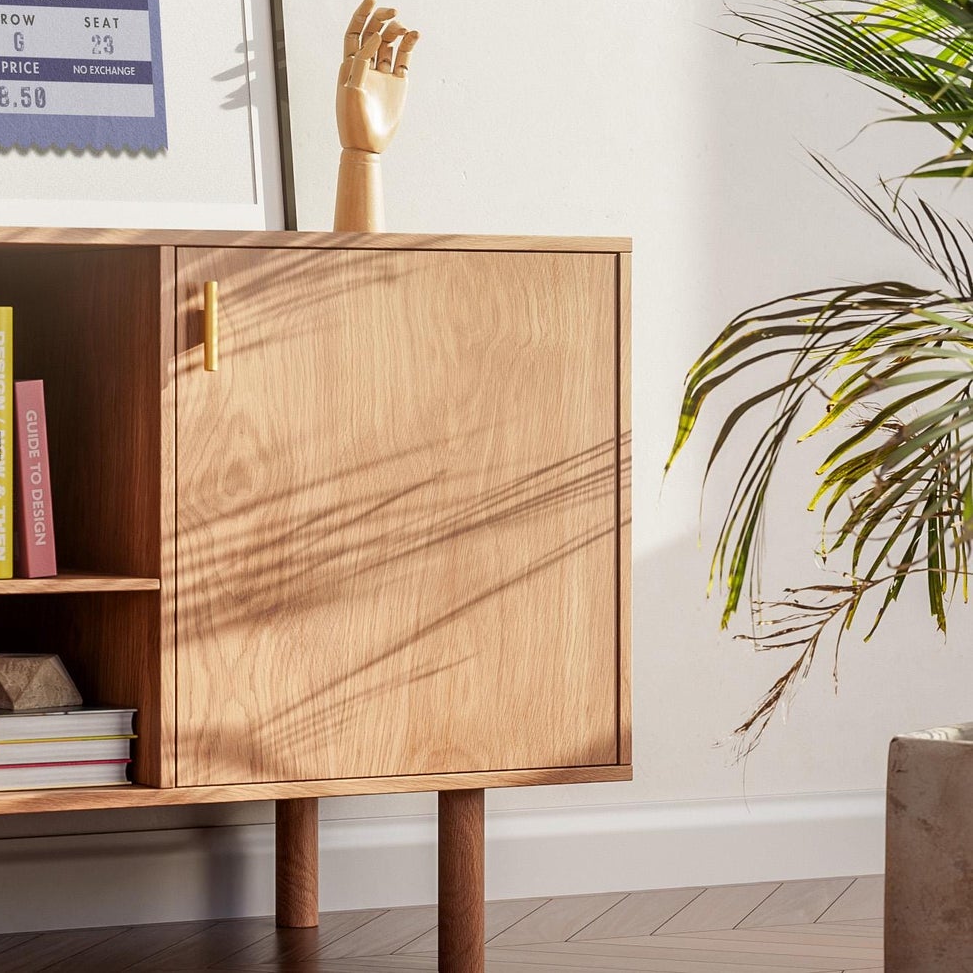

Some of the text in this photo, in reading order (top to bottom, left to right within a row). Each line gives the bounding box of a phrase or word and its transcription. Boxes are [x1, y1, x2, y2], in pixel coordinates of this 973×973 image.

[0, 13, 35, 26] ROW
[84, 16, 120, 29] SEAT
[13, 31, 25, 52] G
[91, 34, 115, 55] 23
[1, 61, 40, 74] PRICE
[73, 65, 136, 76] NO EXCHANGE
[26, 410, 46, 547] GUIDE TO DESIGN
